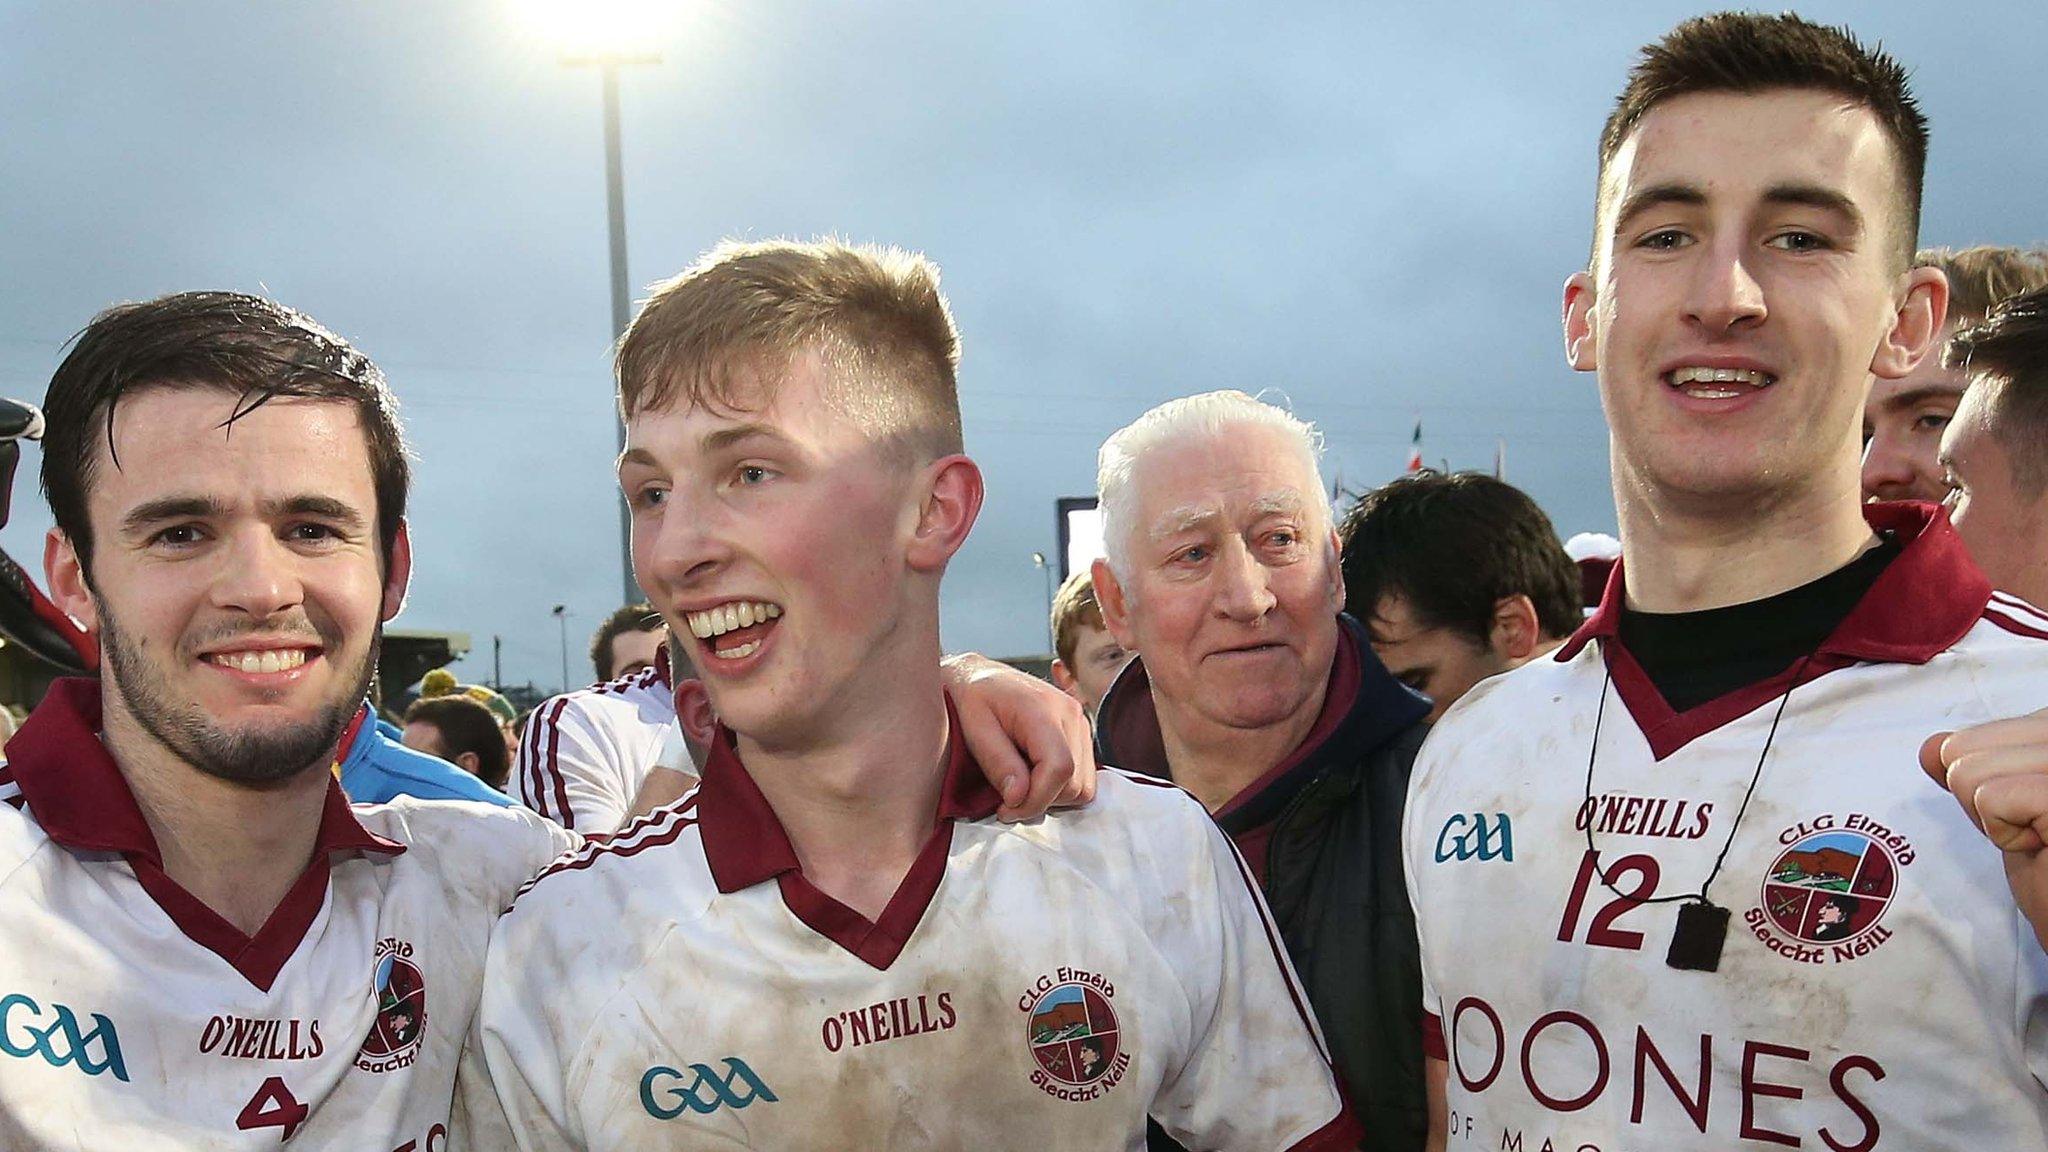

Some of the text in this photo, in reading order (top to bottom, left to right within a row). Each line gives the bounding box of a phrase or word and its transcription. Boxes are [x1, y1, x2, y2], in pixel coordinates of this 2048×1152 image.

[1434, 812, 1514, 864] GAA
[1574, 794, 1714, 840] O'NEILLS
[1778, 814, 1835, 846] CLG
[1556, 849, 1662, 951] 12
[1744, 907, 1893, 964] Sleacht Néill
[1019, 975, 1053, 1012] CLG
[0, 993, 130, 1082] GAA
[200, 1015, 324, 1060] O'NEILLS
[822, 992, 957, 1053] O'NEILLS
[353, 1048, 416, 1073] leacht
[1029, 1051, 1131, 1102] Sleacht Néill
[236, 1076, 309, 1142] 4
[639, 1056, 779, 1120] GAA
[1450, 1110, 1474, 1140] OF
